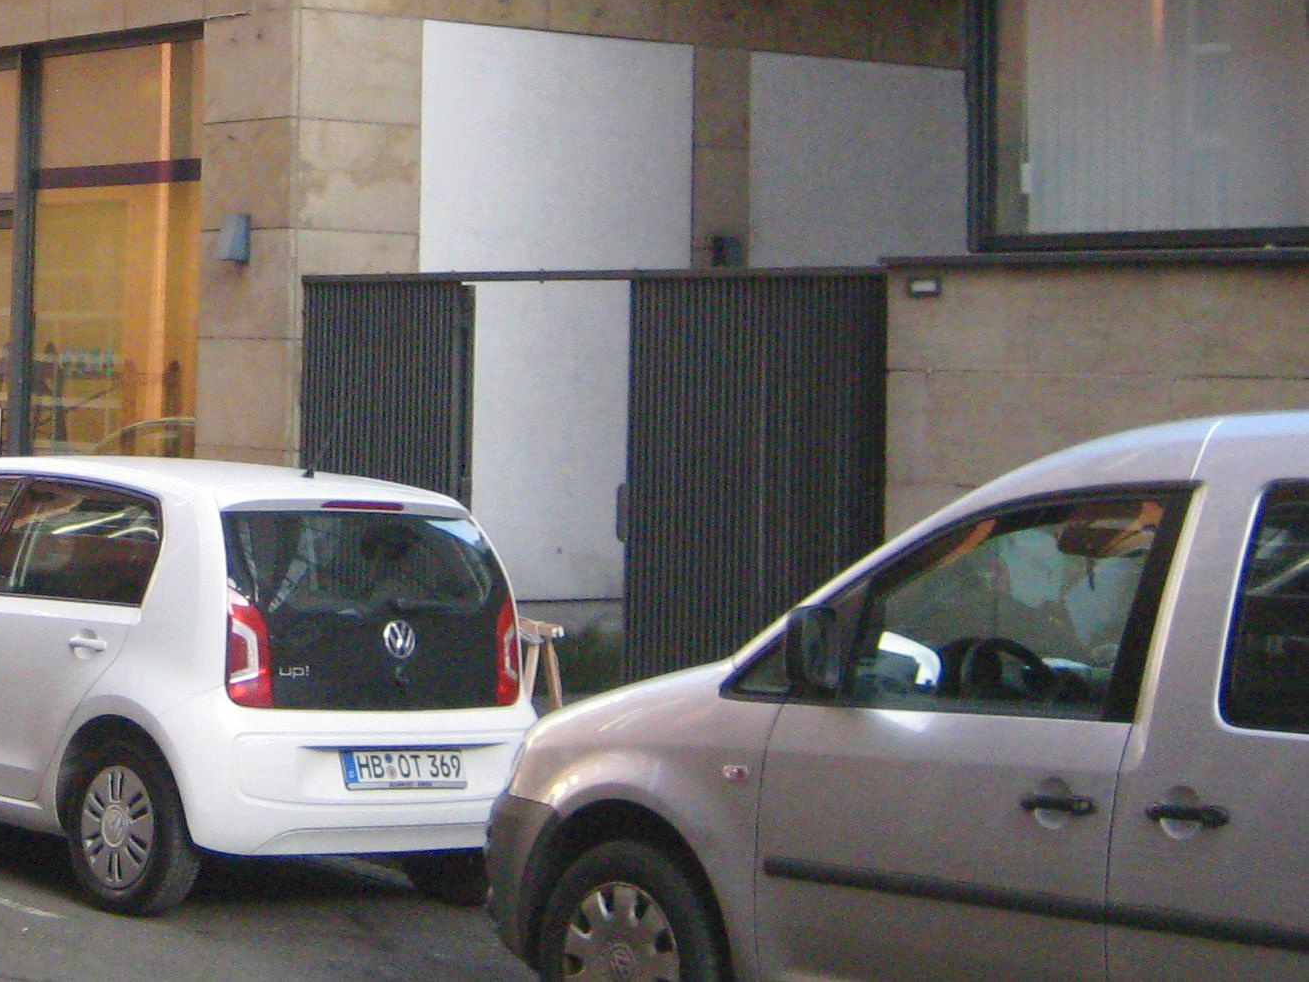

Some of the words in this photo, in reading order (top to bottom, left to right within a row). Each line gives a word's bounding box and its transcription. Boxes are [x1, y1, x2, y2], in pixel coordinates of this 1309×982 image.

[279, 665, 310, 679] up!
[356, 755, 385, 779] HB
[398, 754, 421, 778] OT
[427, 754, 461, 778] 369
